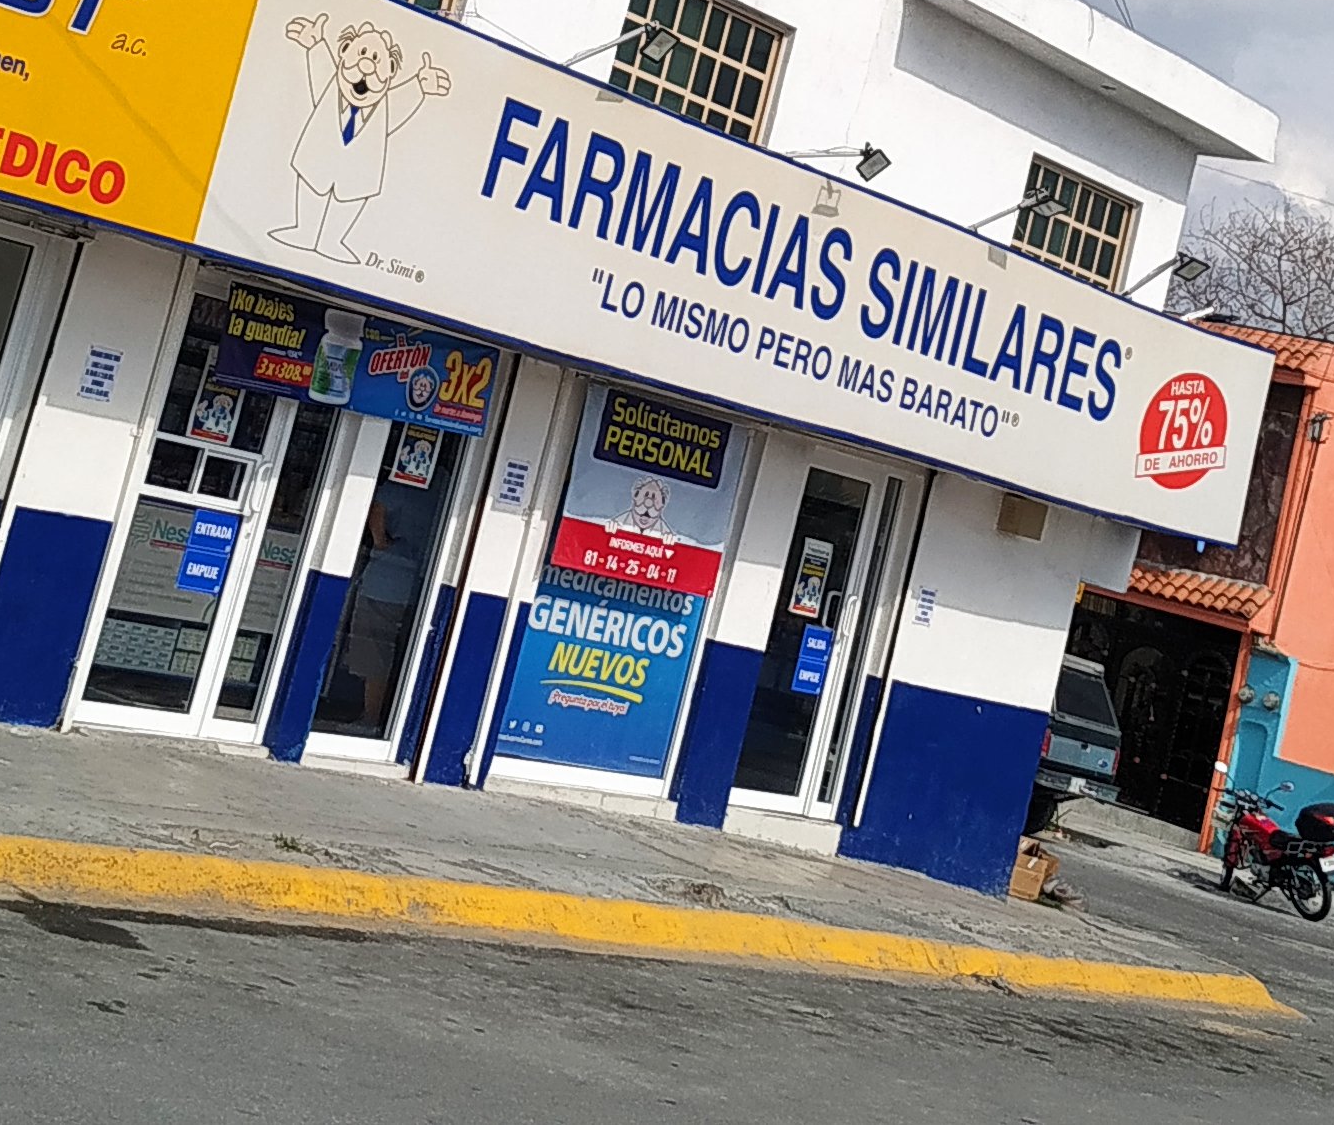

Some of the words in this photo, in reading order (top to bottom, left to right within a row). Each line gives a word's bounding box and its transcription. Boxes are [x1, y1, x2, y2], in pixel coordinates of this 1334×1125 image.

[111, 31, 148, 57] a.c.
[365, 251, 385, 271] Dr.
[386, 258, 417, 279] Simi
[478, 96, 857, 321] FARMACIAS
[860, 245, 1123, 422] SIMILARES
[254, 294, 295, 322] bajes
[227, 313, 245, 336] la
[591, 267, 646, 319] "LO
[650, 291, 751, 354] MISMO
[755, 328, 833, 382] PERO
[836, 355, 895, 404] MAS
[370, 342, 431, 373] OFERTÓN
[1170, 379, 1206, 396] HASTA
[612, 396, 721, 449] Solicitamos
[1158, 396, 1213, 450] 75%
[603, 424, 713, 478] PERSONAL
[1144, 457, 1161, 472] DE
[1168, 451, 1219, 469] AHORRO
[194, 521, 233, 540] ENTRADA
[609, 536, 646, 555] INFORMES
[185, 561, 220, 581] EMPUJE
[541, 563, 695, 616] medicamentos
[527, 593, 688, 658] GENÉRICOS
[547, 641, 651, 687] NUEVOS
